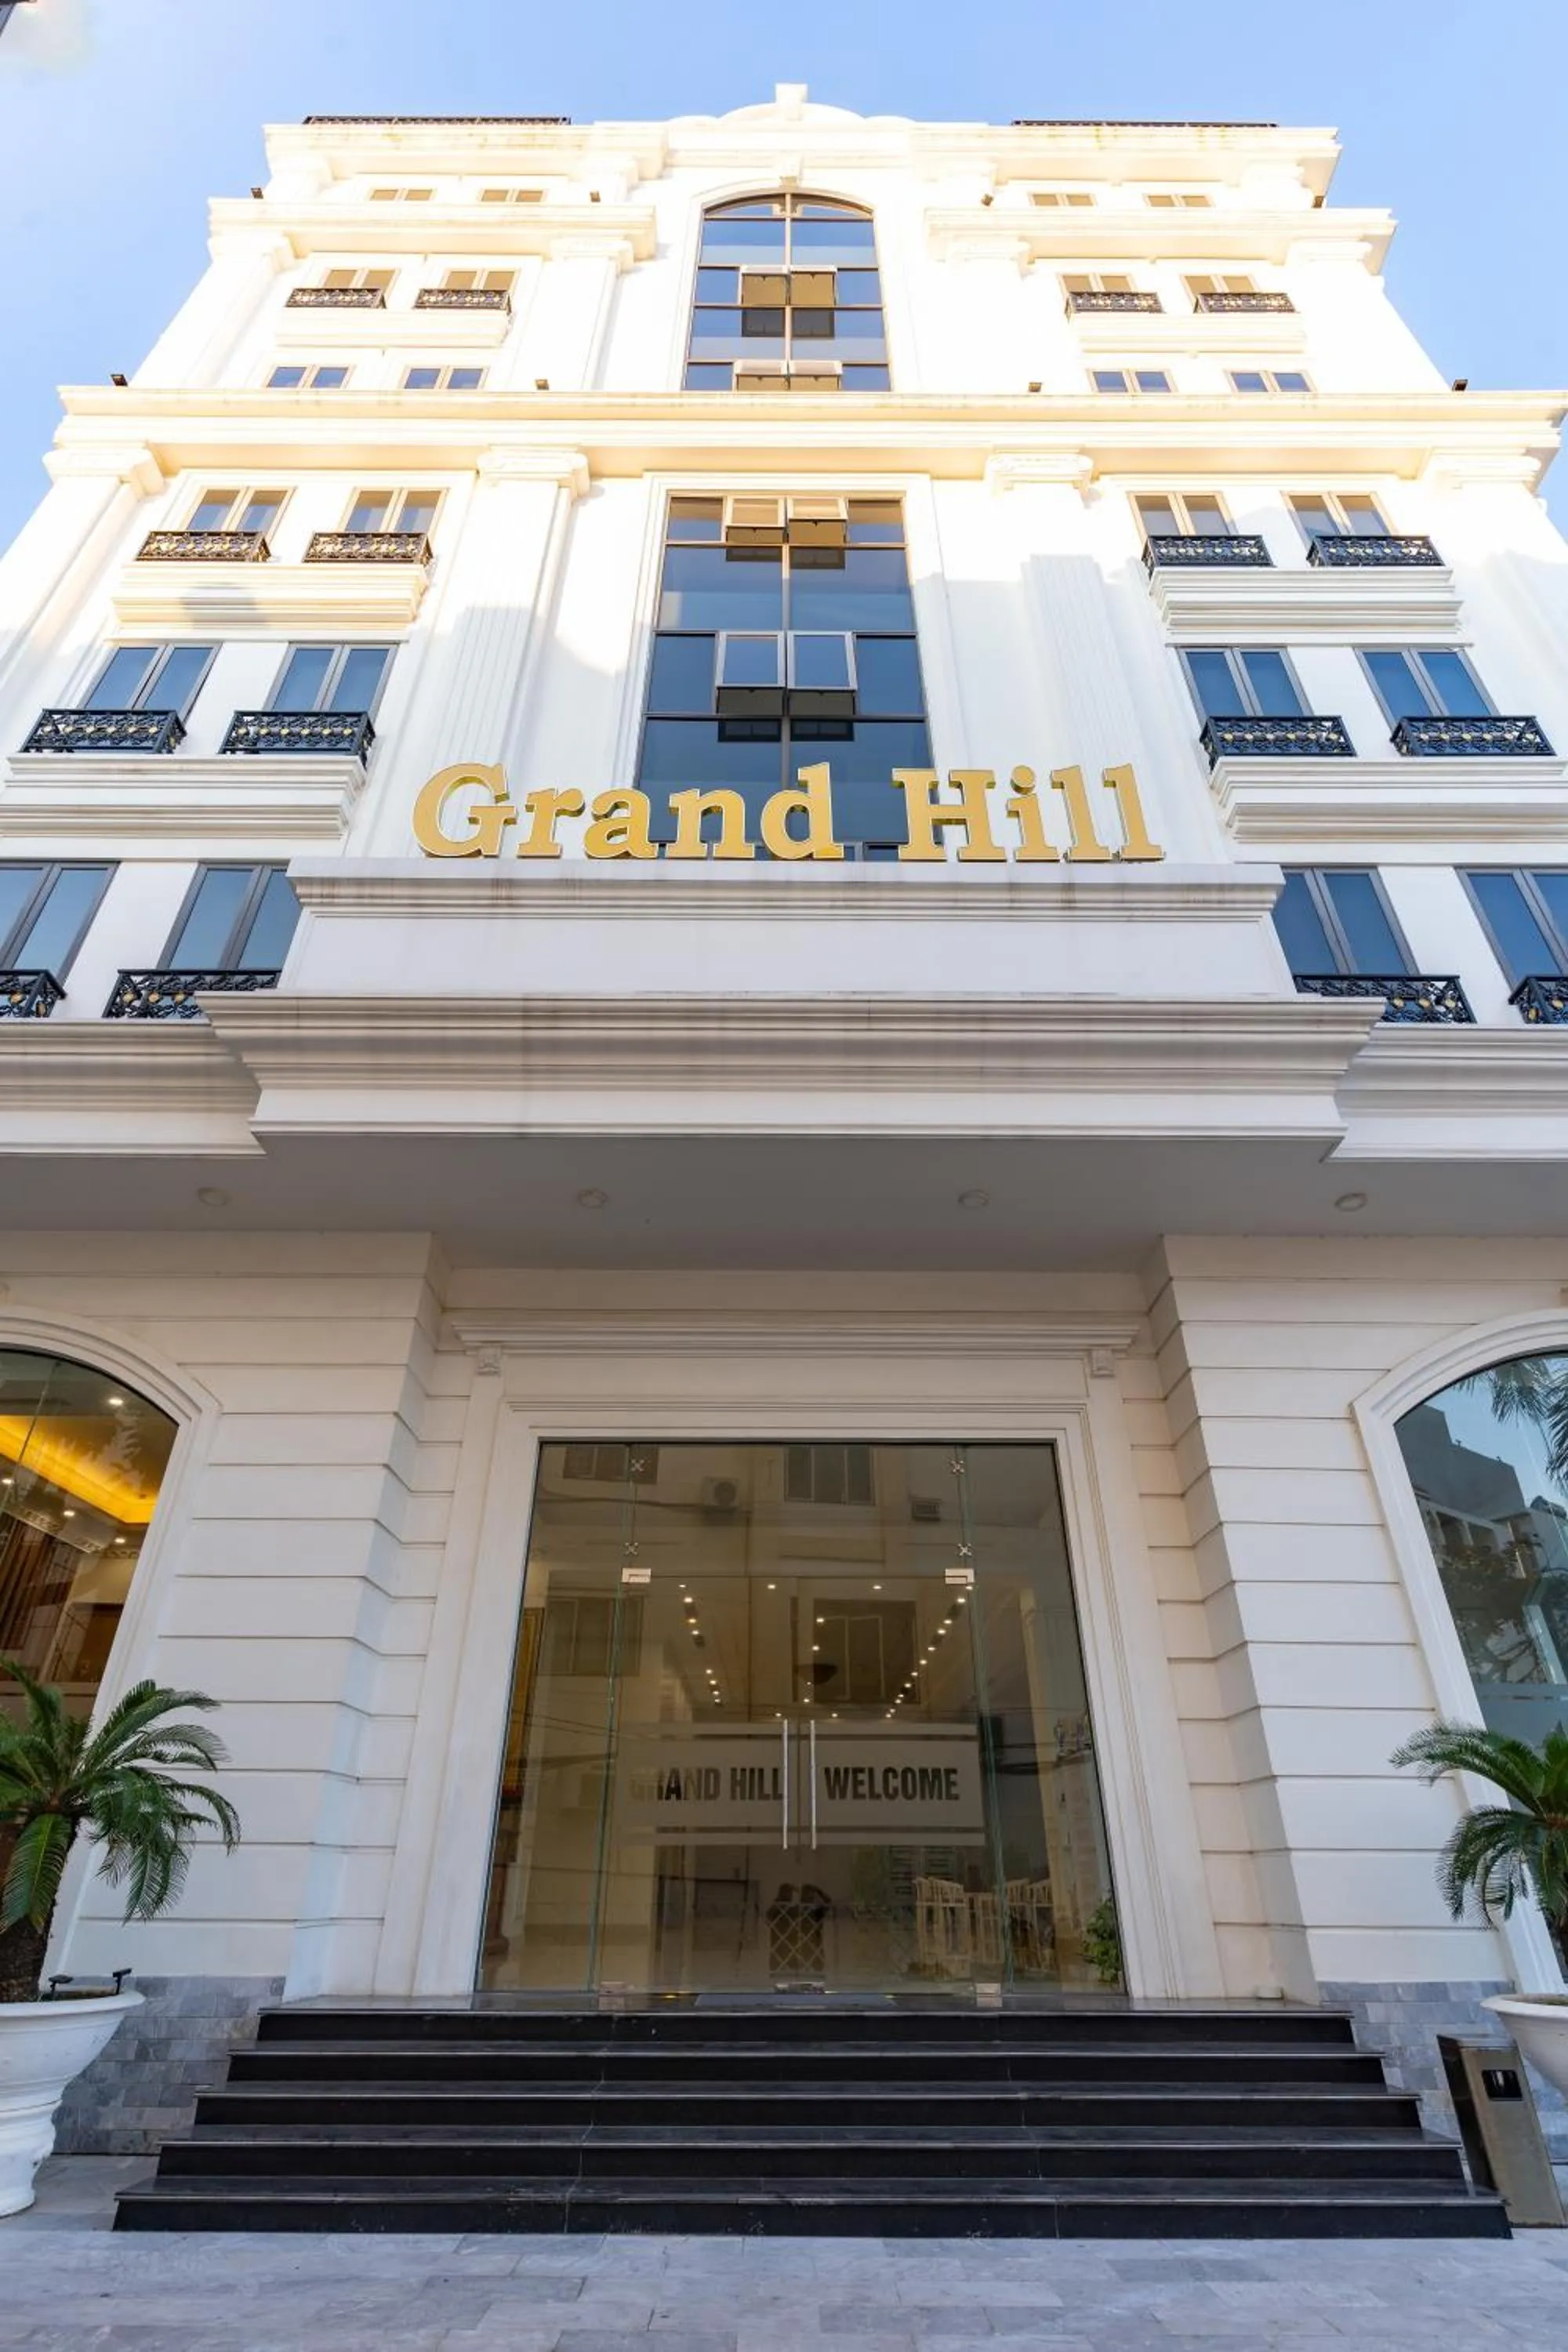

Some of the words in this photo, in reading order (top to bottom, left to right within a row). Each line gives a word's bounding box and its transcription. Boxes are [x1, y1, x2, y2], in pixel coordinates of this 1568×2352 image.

[412, 761, 844, 859] Grand
[891, 763, 1165, 862] Hill
[730, 1766, 784, 1801] HILL
[824, 1766, 960, 1801] WELCOME
